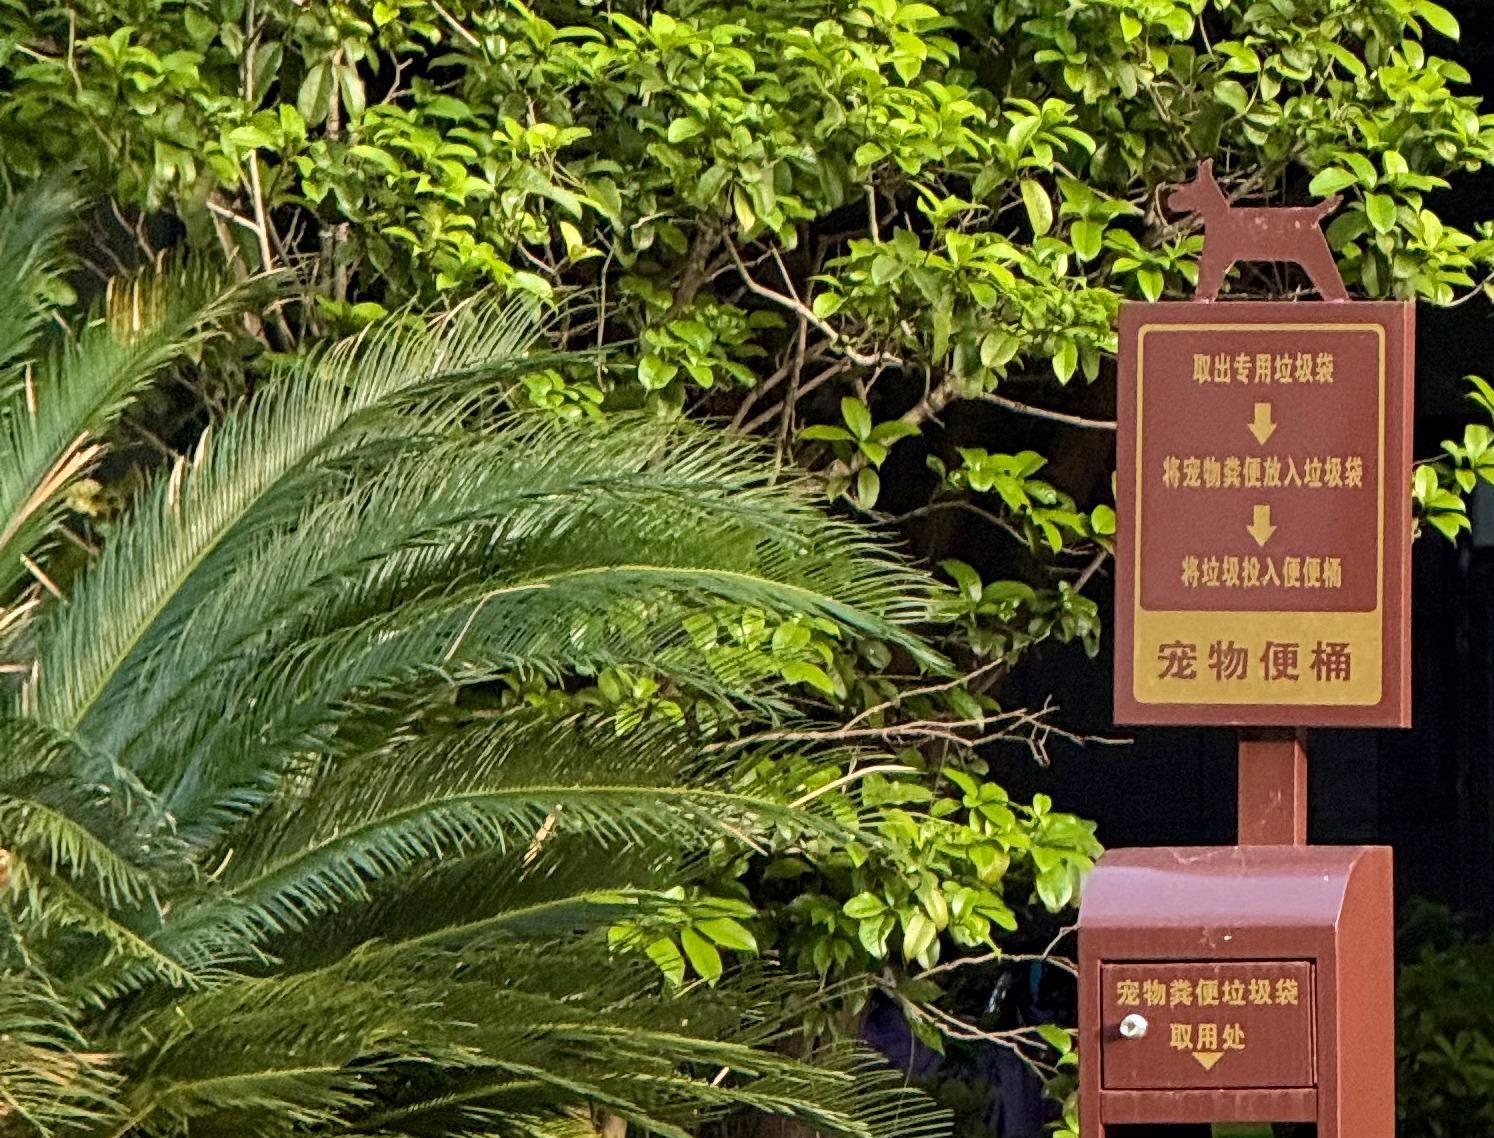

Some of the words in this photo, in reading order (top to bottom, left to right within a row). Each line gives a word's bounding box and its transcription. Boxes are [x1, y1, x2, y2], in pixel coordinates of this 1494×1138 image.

[1193, 352, 1334, 384] 取出专用垃圾袋
[1162, 456, 1363, 489] 将宠物粪便放入垃圾袋
[1181, 555, 1342, 589] 将垃圾投入便便桶
[1157, 639, 1352, 682] 宠物便桶
[1116, 978, 1299, 1007] 宠物粪便垃圾袋
[1169, 1022, 1246, 1050] 取用处
